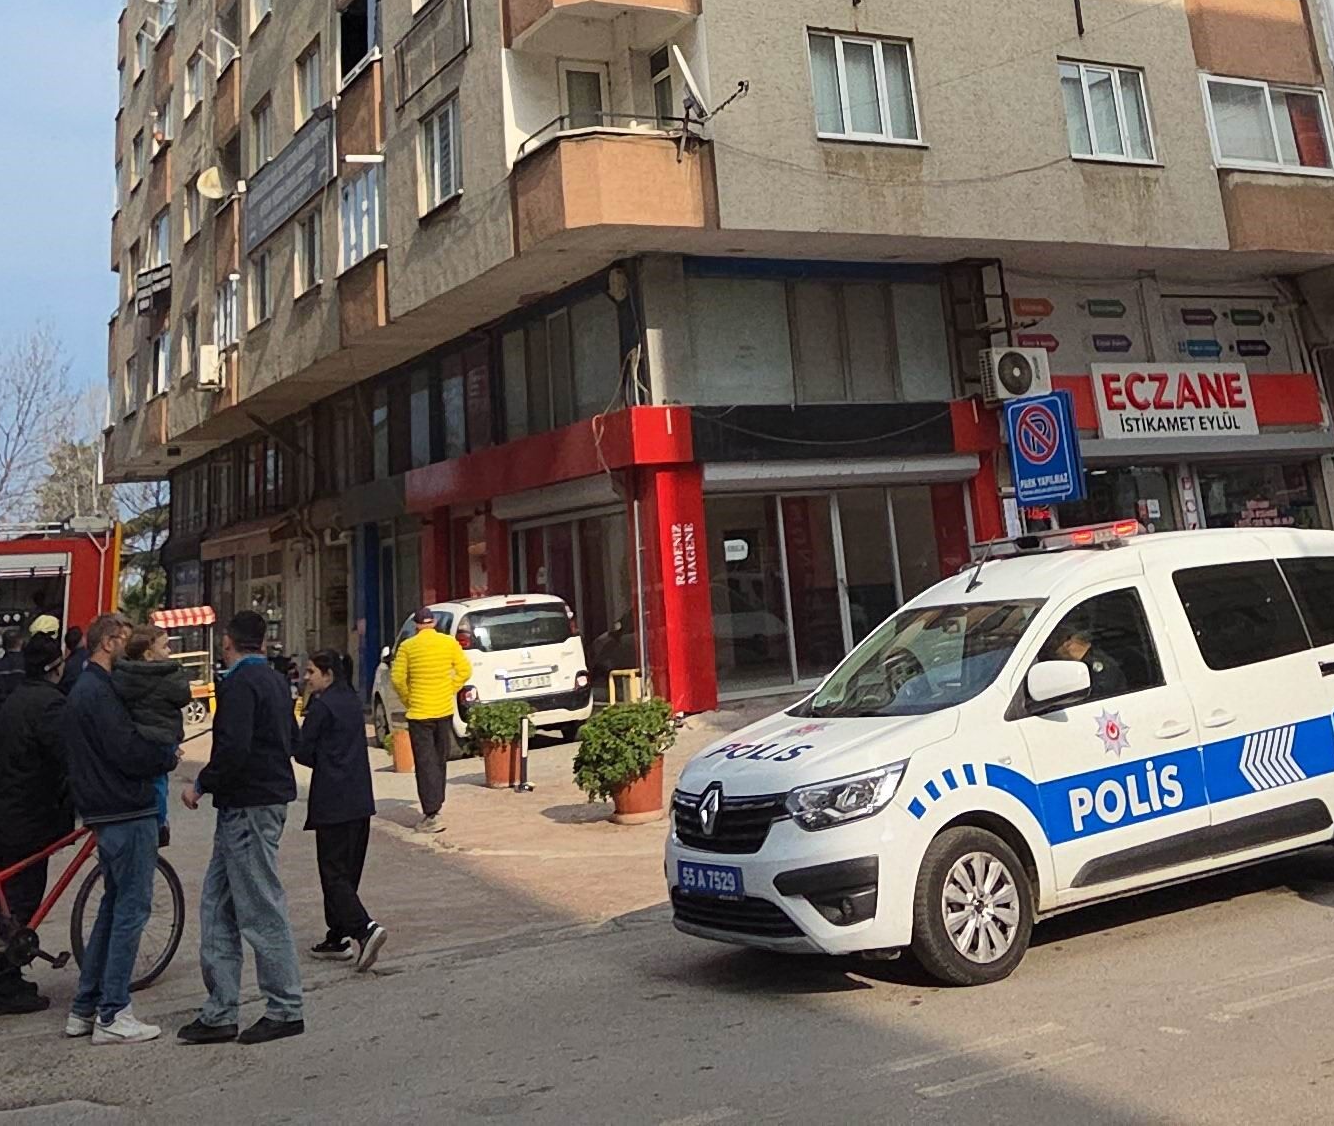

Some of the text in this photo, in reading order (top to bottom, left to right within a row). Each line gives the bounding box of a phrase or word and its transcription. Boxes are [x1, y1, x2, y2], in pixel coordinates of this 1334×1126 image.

[1101, 372, 1247, 411] ECZANE
[1119, 411, 1241, 433] İSTİKAMET EYLÜL
[1068, 760, 1184, 832] POLİS
[697, 869, 707, 888] A
[707, 870, 736, 892] 7529
